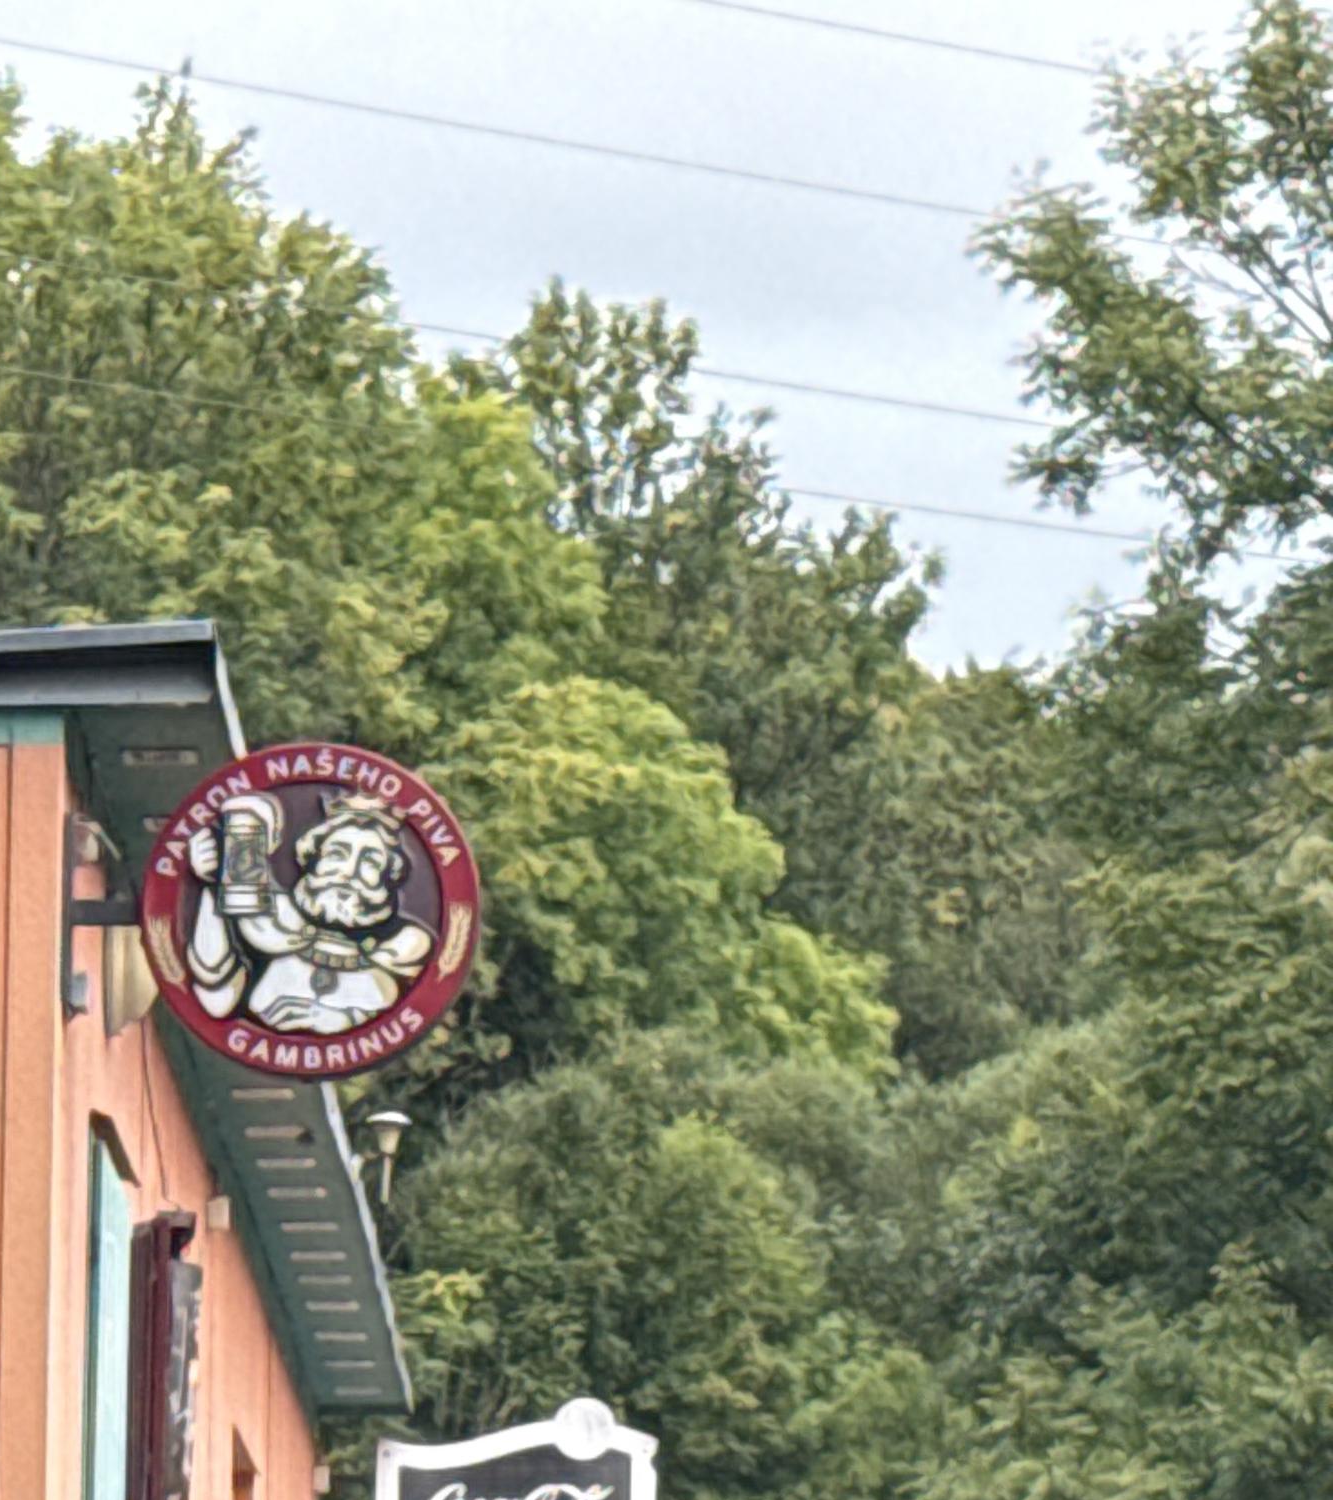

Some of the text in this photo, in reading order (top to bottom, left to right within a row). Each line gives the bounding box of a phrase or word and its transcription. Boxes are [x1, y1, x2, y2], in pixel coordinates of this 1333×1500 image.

[156, 748, 461, 876] PATRON NAŠEHO PIVA
[227, 1006, 424, 1069] GAMBRINUS
